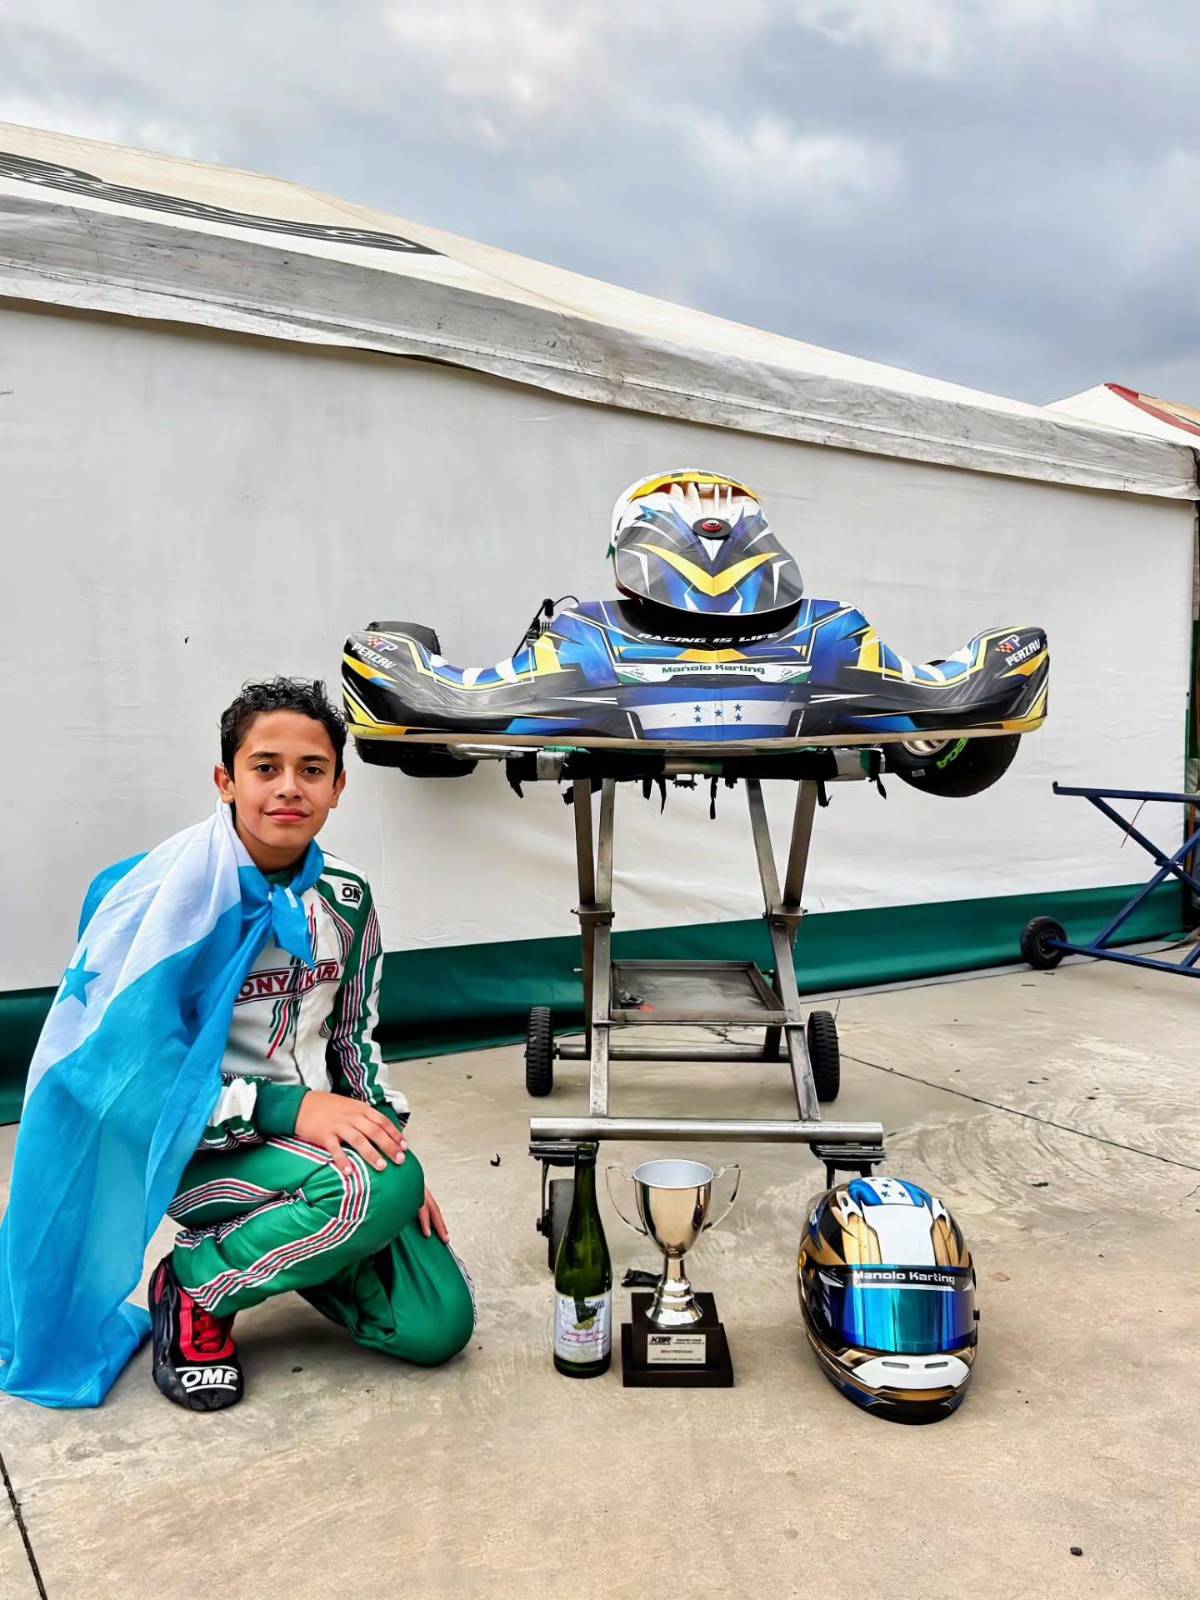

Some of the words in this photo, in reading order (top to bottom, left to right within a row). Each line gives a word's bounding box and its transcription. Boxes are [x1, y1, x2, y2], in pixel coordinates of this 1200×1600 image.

[637, 633, 706, 643] RACING
[715, 663, 766, 675] Karting
[853, 1270, 906, 1281] Manolo
[909, 1271, 955, 1285] Karting
[180, 1368, 238, 1387] OMP
